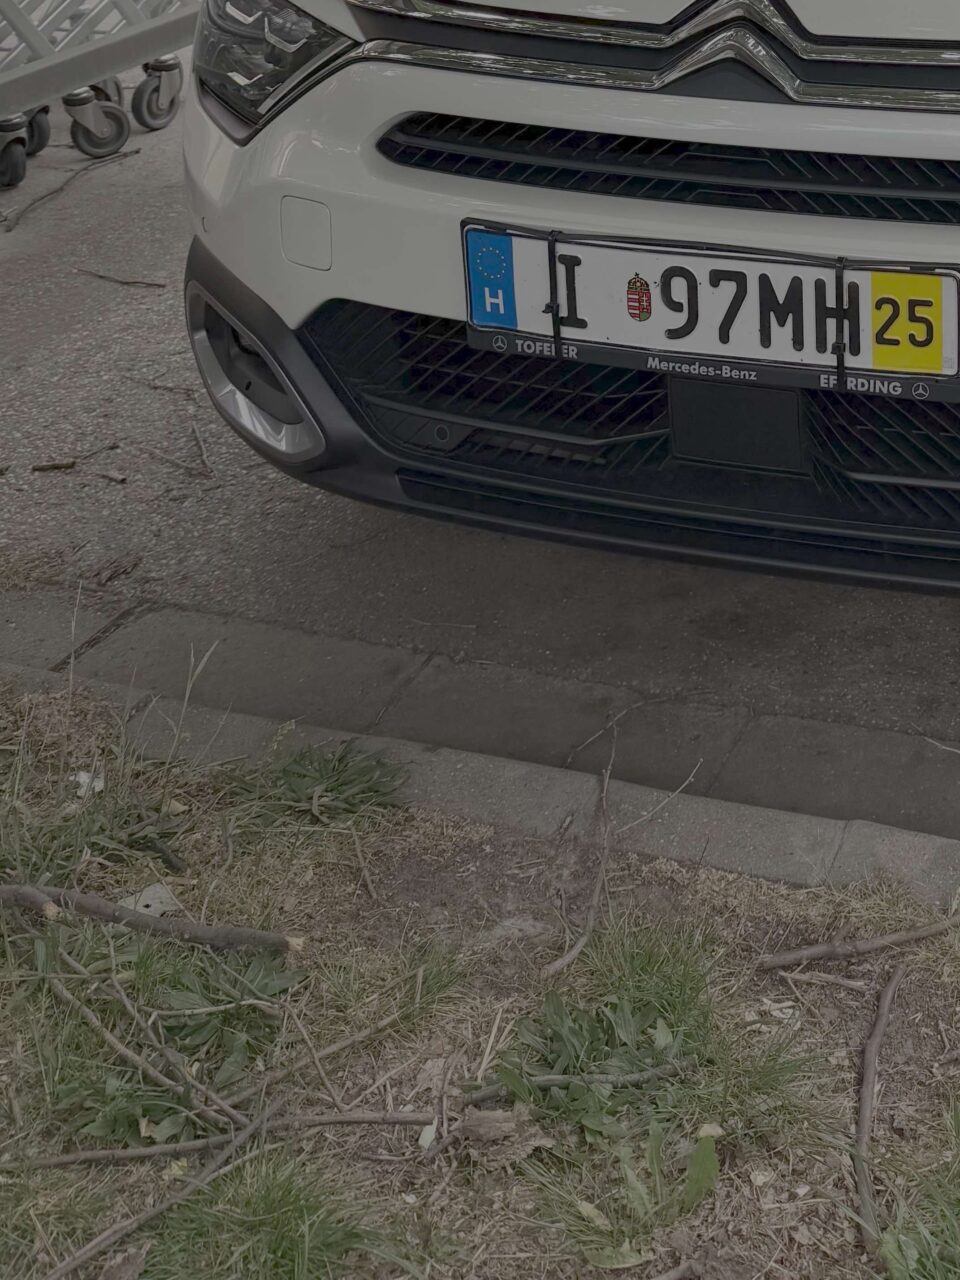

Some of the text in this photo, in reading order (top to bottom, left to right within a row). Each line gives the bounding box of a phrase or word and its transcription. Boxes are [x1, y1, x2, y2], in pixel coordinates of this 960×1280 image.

[483, 286, 505, 315] H
[557, 253, 936, 357] I 97MH 25
[646, 355, 758, 382] Mercedes-Benz
[819, 373, 903, 395] EFRDING
